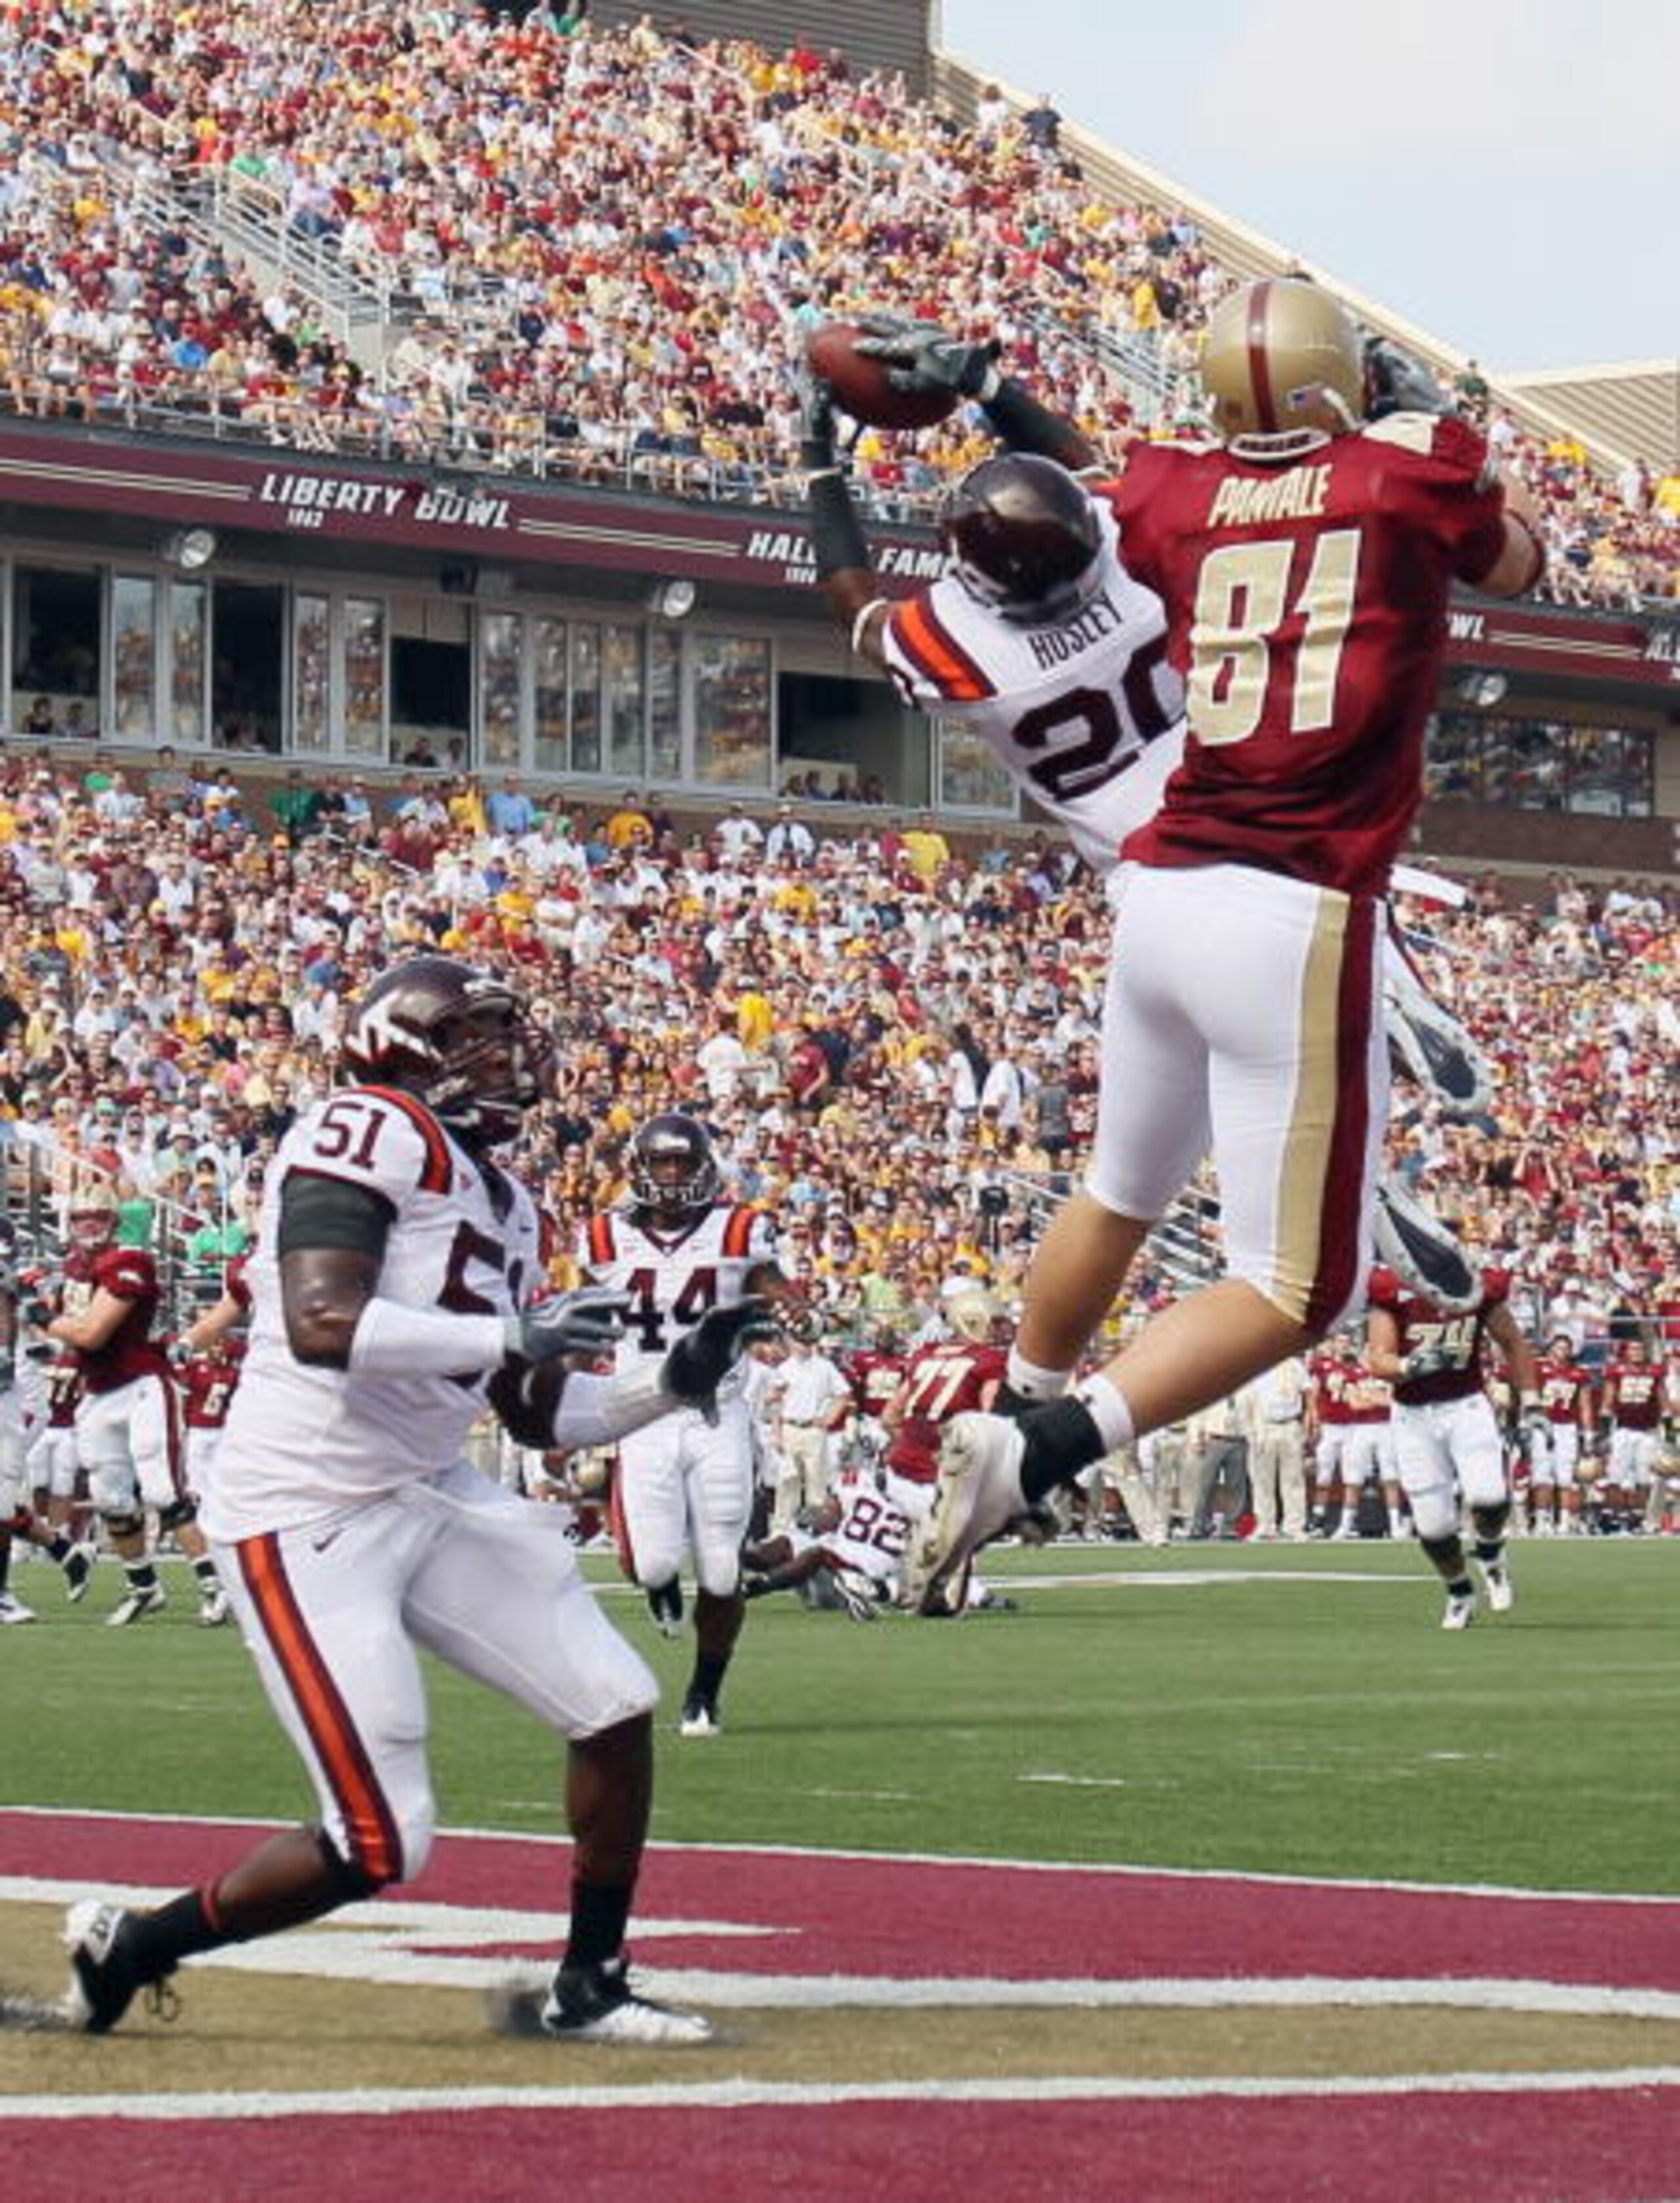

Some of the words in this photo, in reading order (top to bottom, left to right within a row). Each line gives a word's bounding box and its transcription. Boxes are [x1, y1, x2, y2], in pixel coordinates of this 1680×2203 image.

[260, 473, 405, 516] LIBERTY
[414, 491, 509, 529] BOWL
[1028, 589, 1122, 671] HOSLEY
[1186, 529, 1362, 747] 81
[314, 1101, 386, 1171] 51
[621, 1269, 717, 1352] 44
[904, 1356, 977, 1421] 77
[845, 1498, 911, 1558] 82
